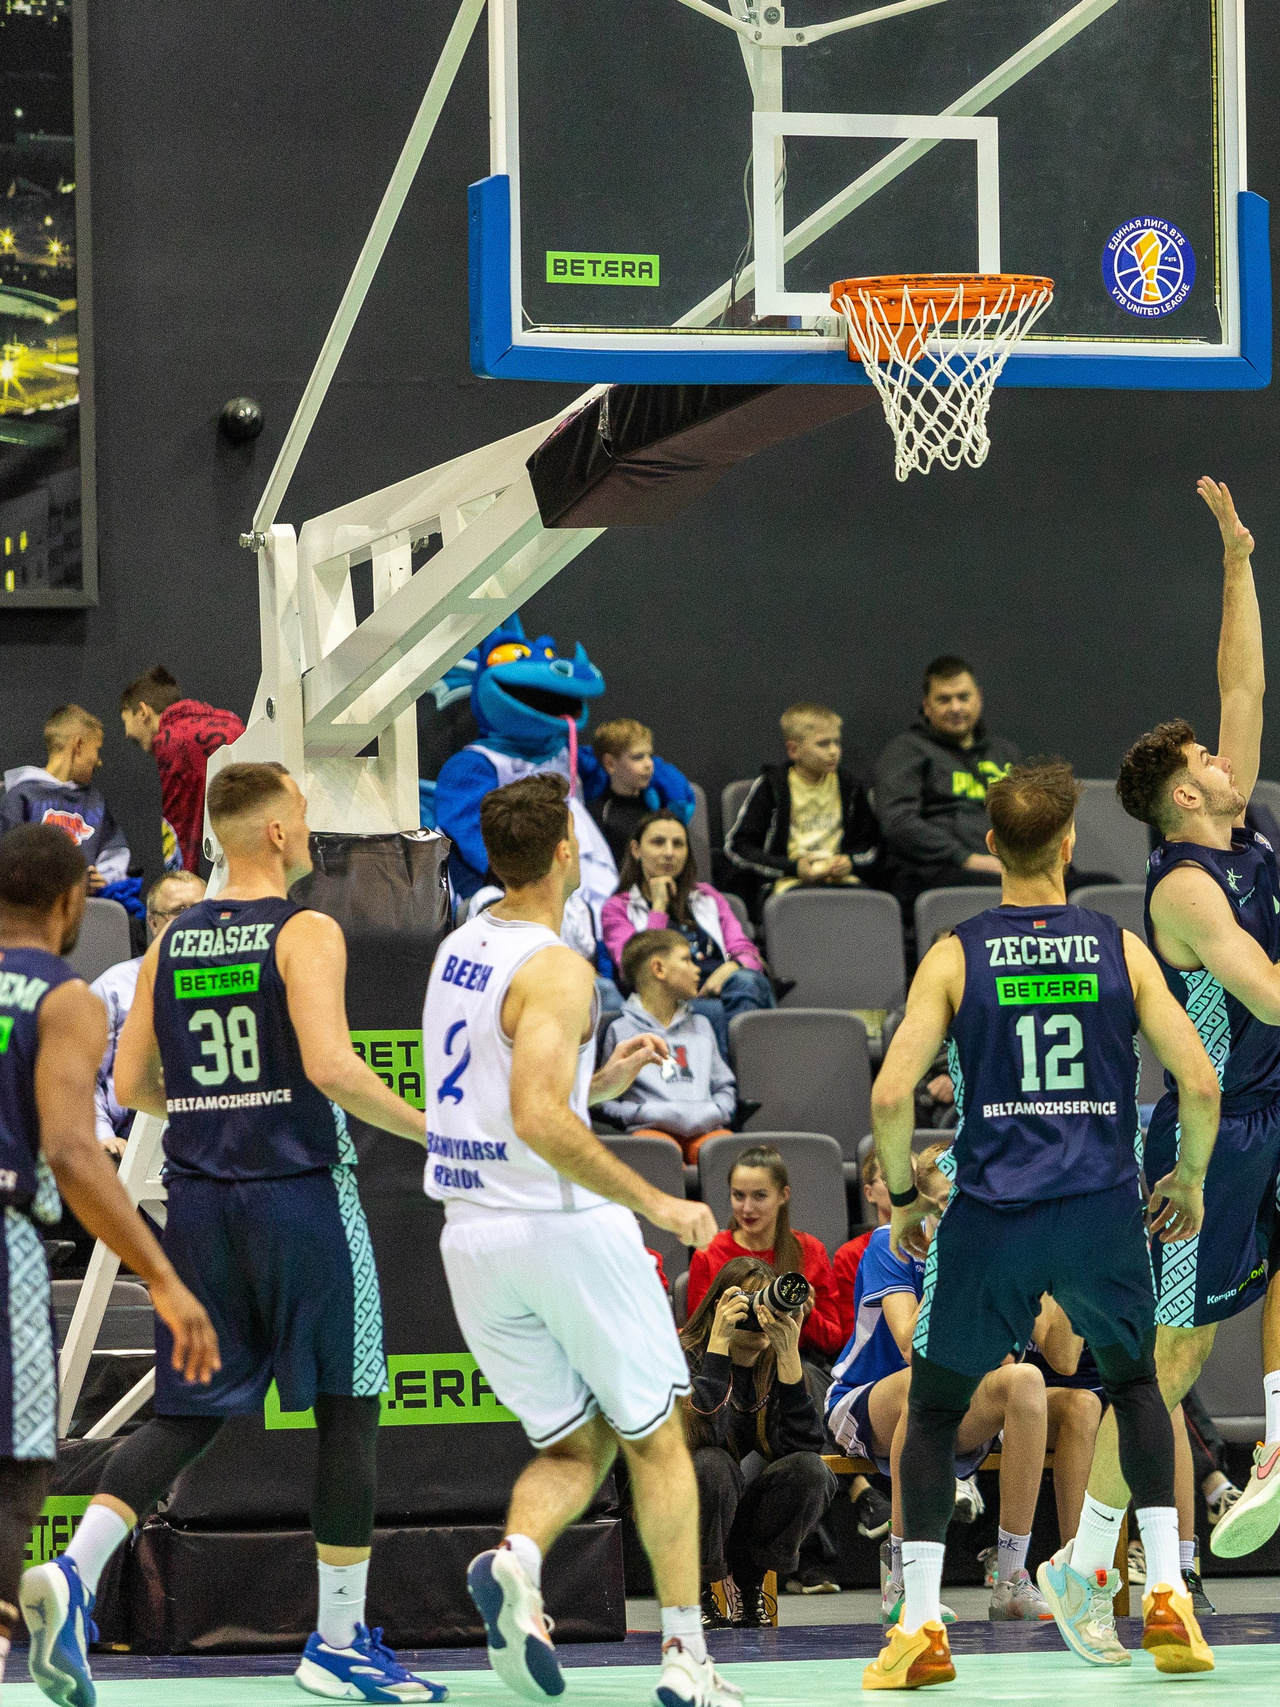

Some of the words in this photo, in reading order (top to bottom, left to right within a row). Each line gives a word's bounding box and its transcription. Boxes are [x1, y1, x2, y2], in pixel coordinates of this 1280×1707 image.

[1108, 219, 1141, 251] ЕДИНАЯ
[1143, 218, 1169, 232] ЛИГА
[1168, 228, 1186, 246] ВТБ
[1112, 286, 1127, 305] VTB
[1126, 301, 1160, 316] UNITED
[1160, 283, 1190, 313] LEAGUE
[169, 923, 275, 958] CEBASEK
[985, 935, 1100, 967] ZECEVIC
[188, 1005, 261, 1086] 38
[437, 1019, 471, 1106] 2
[1015, 1013, 1085, 1093] 12
[982, 1100, 1117, 1118] BELTAMOZHSERVICE
